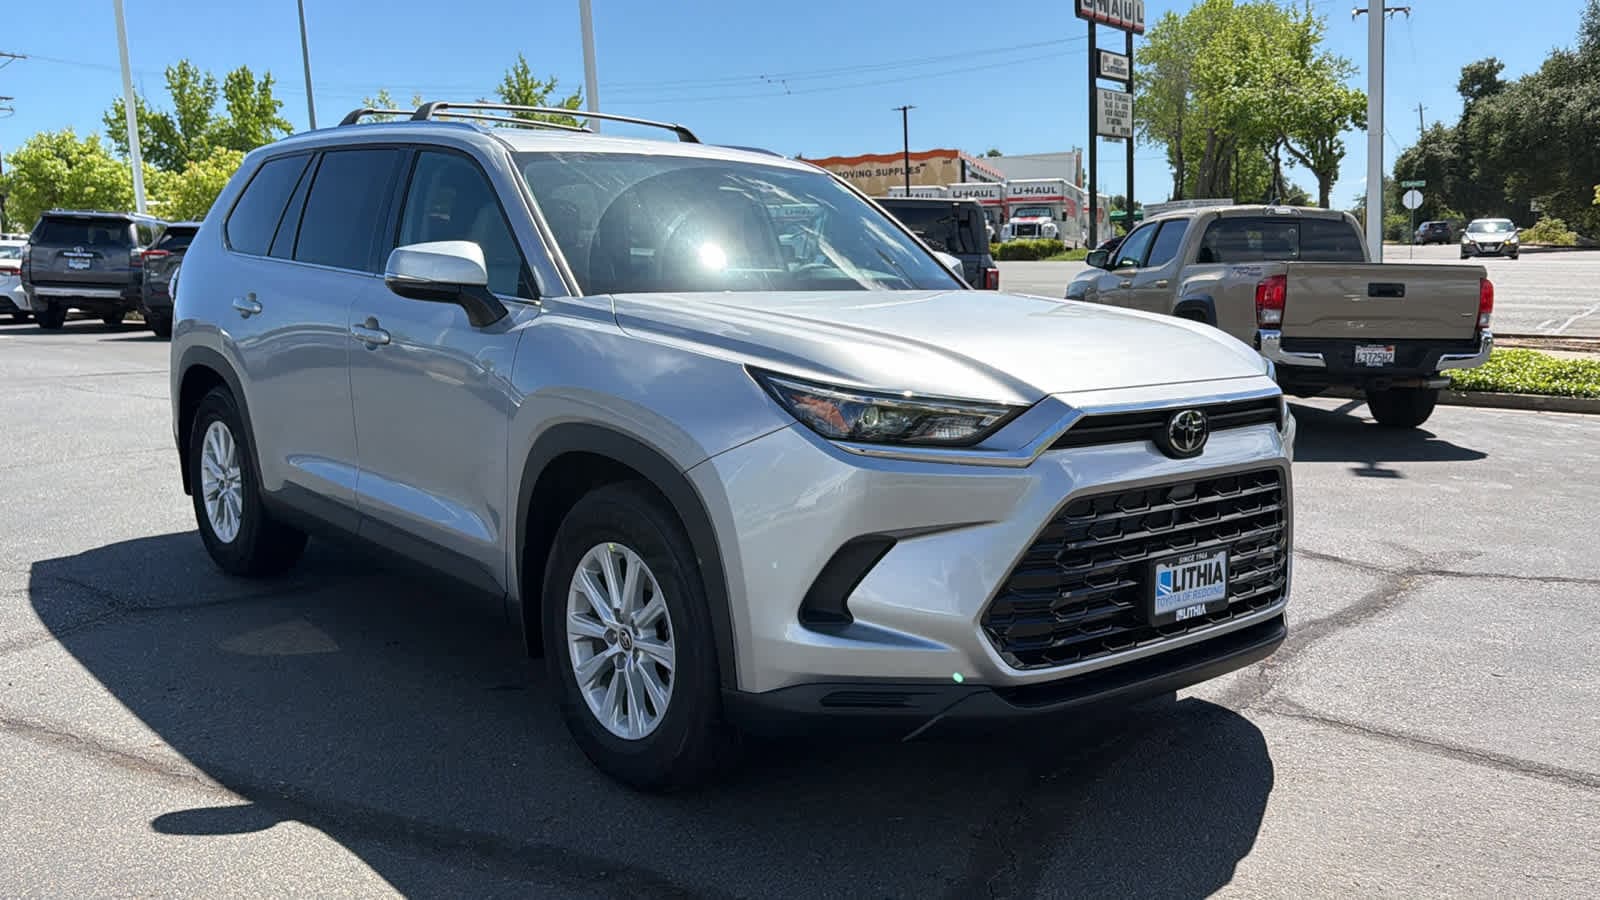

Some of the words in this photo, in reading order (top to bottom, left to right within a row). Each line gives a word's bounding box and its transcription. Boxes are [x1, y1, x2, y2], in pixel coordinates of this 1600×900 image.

[875, 166, 921, 177] SUPPLES
[952, 189, 996, 198] U-HAUL
[1012, 186, 1058, 195] U-HAUL
[1179, 554, 1195, 563] SINCE
[1172, 561, 1224, 593] LITHIA
[1183, 603, 1207, 619] LITHIA
